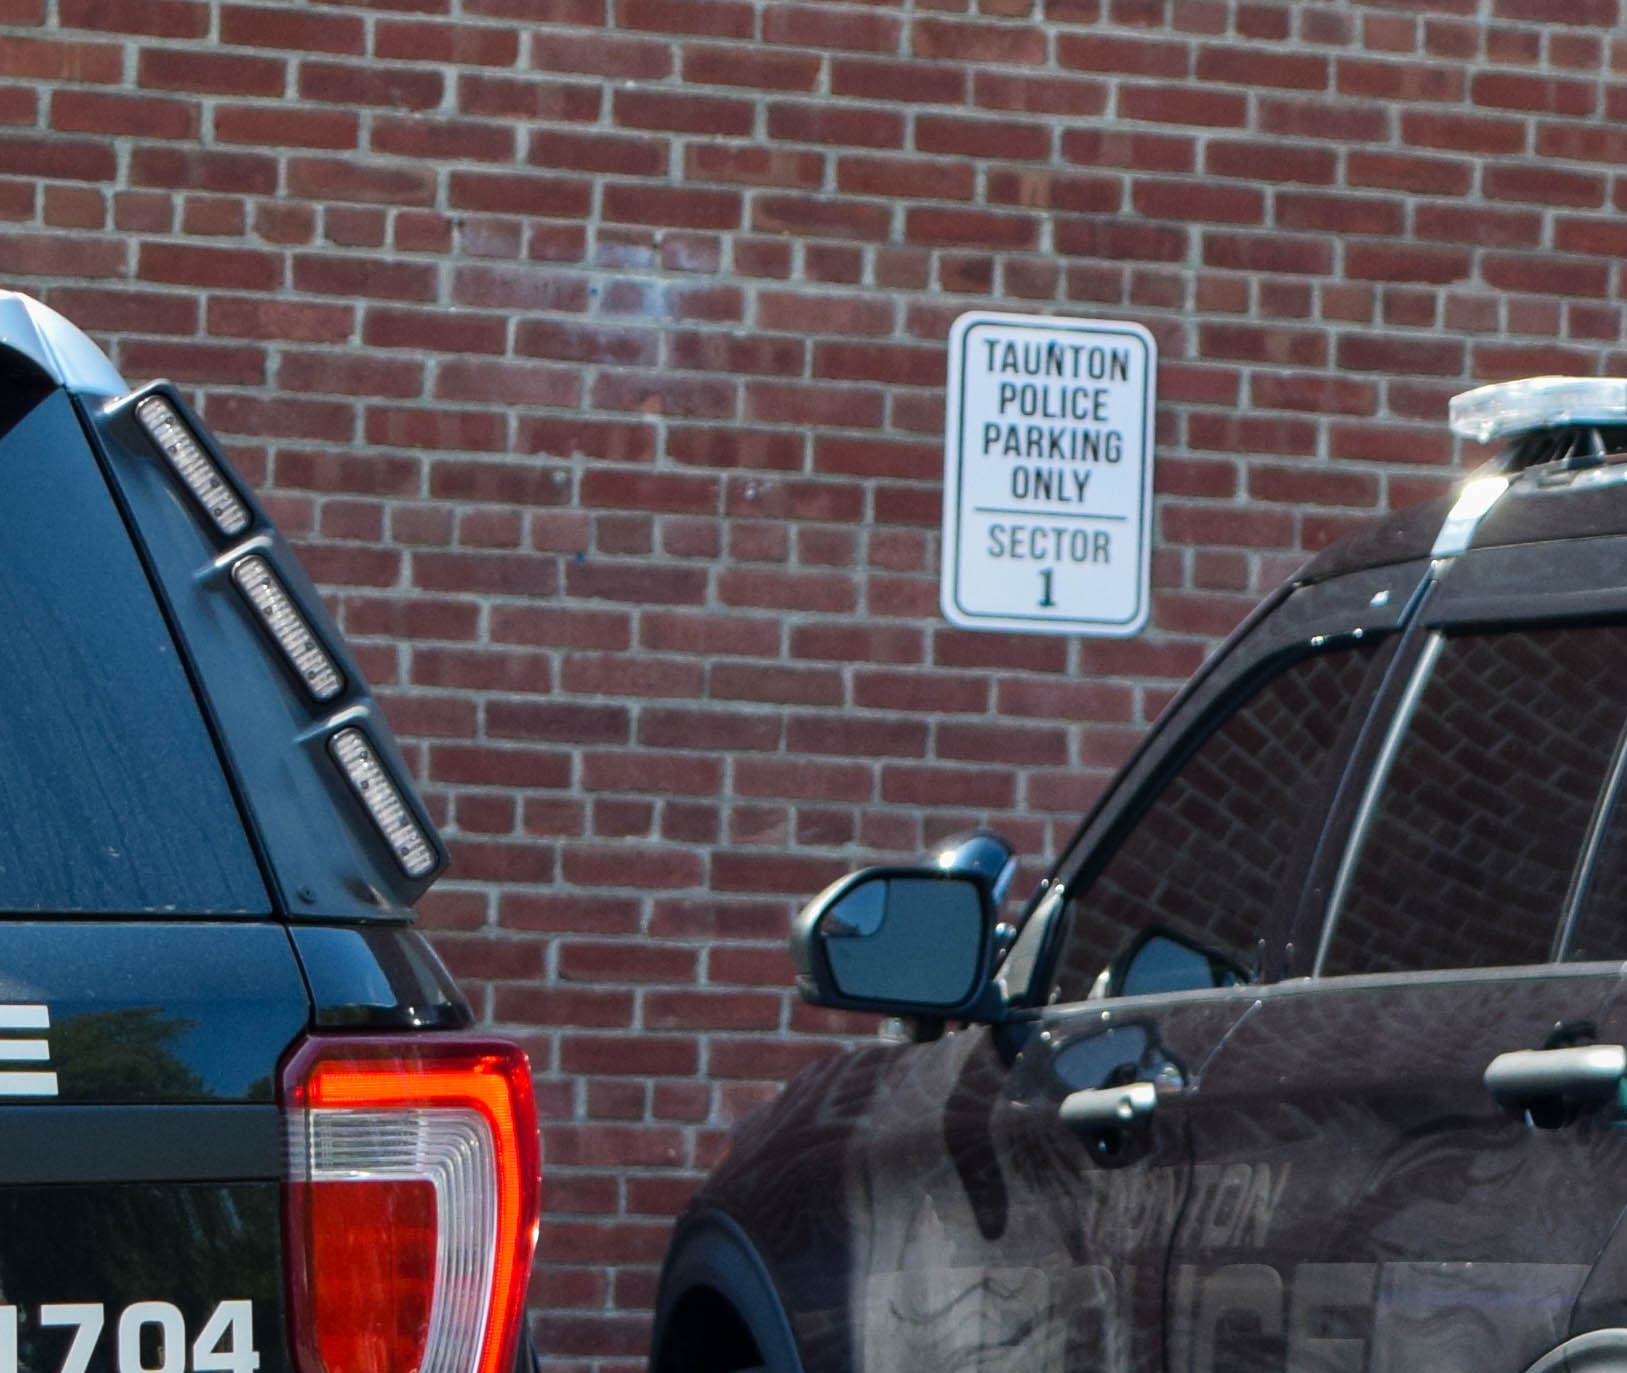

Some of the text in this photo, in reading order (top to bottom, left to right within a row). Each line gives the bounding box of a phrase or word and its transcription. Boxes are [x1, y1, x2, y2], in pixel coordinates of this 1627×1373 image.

[985, 339, 1130, 382] TAUNTON
[1000, 381, 1109, 421] POLICE
[983, 422, 1123, 463] PARKING
[1011, 466, 1091, 503] ONLY
[987, 523, 1112, 565] SECTOR
[1038, 566, 1056, 608] 1
